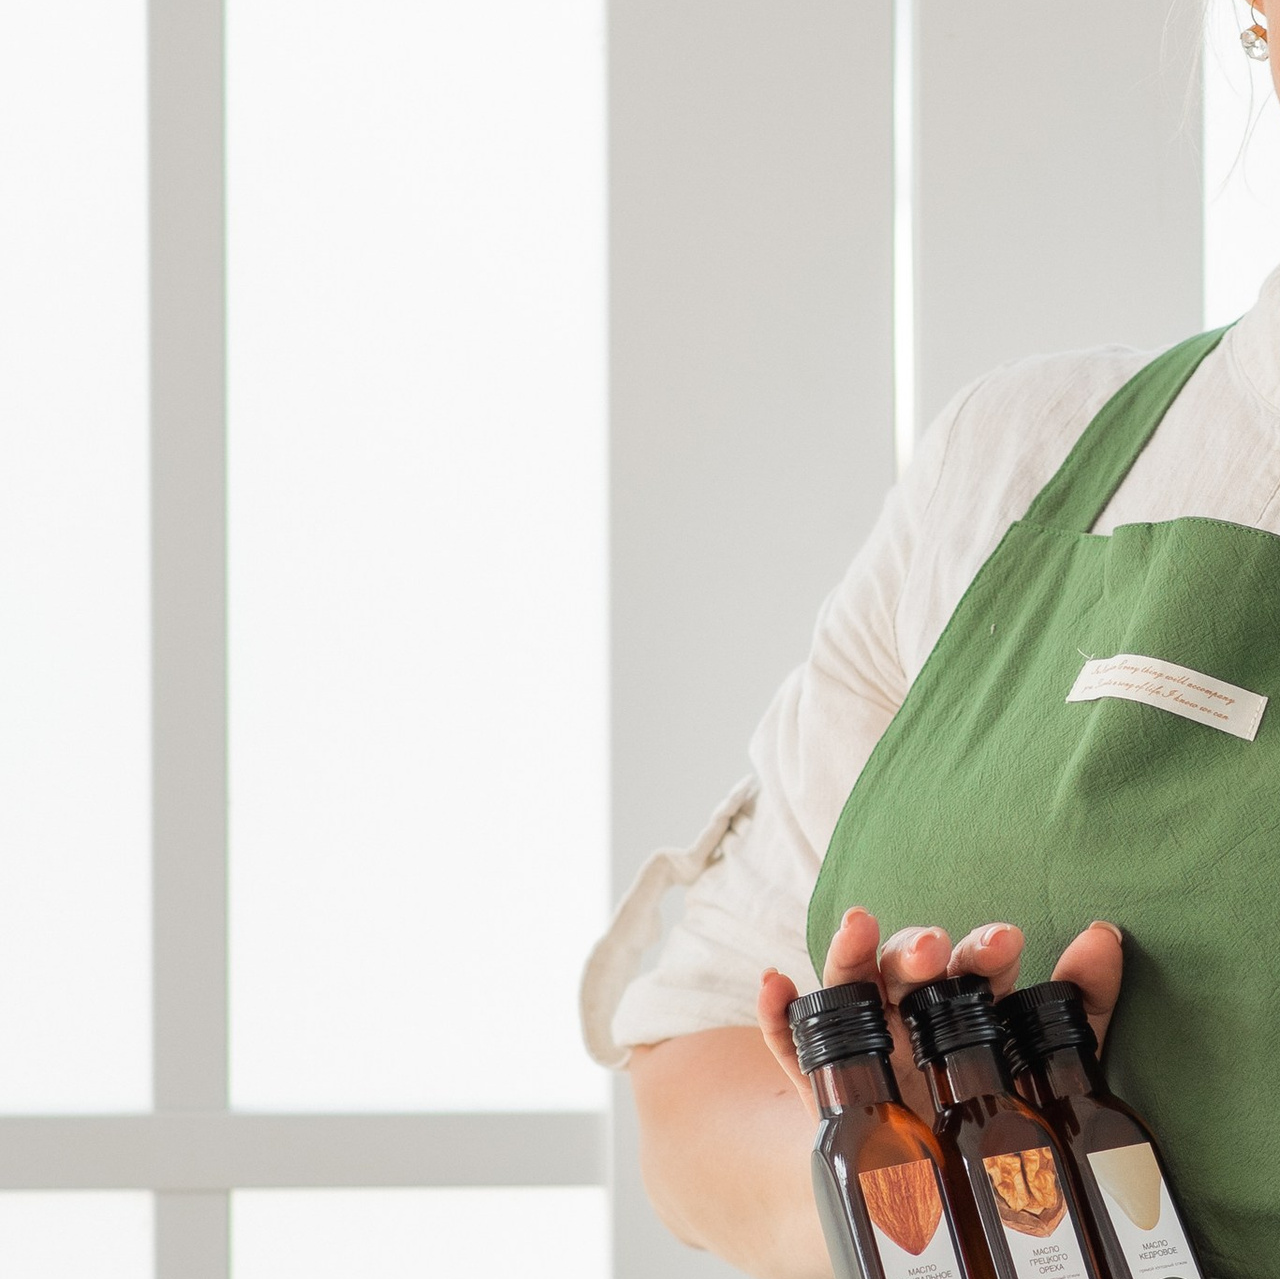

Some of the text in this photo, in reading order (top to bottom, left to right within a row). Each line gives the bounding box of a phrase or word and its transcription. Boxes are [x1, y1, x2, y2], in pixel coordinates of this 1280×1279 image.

[1165, 676, 1190, 684] will
[1187, 683, 1235, 705] accompany
[1173, 693, 1198, 708] know
[1213, 711, 1229, 720] can
[1032, 1245, 1060, 1257] МАСЛО
[1142, 1240, 1168, 1250] МАСЛО
[1139, 1247, 1178, 1260] КЕДРОВОЕ
[1029, 1253, 1069, 1267] ГРЕЦКОГО
[908, 1264, 937, 1276] МАСЛО
[1038, 1263, 1065, 1275] ОРЕХА
